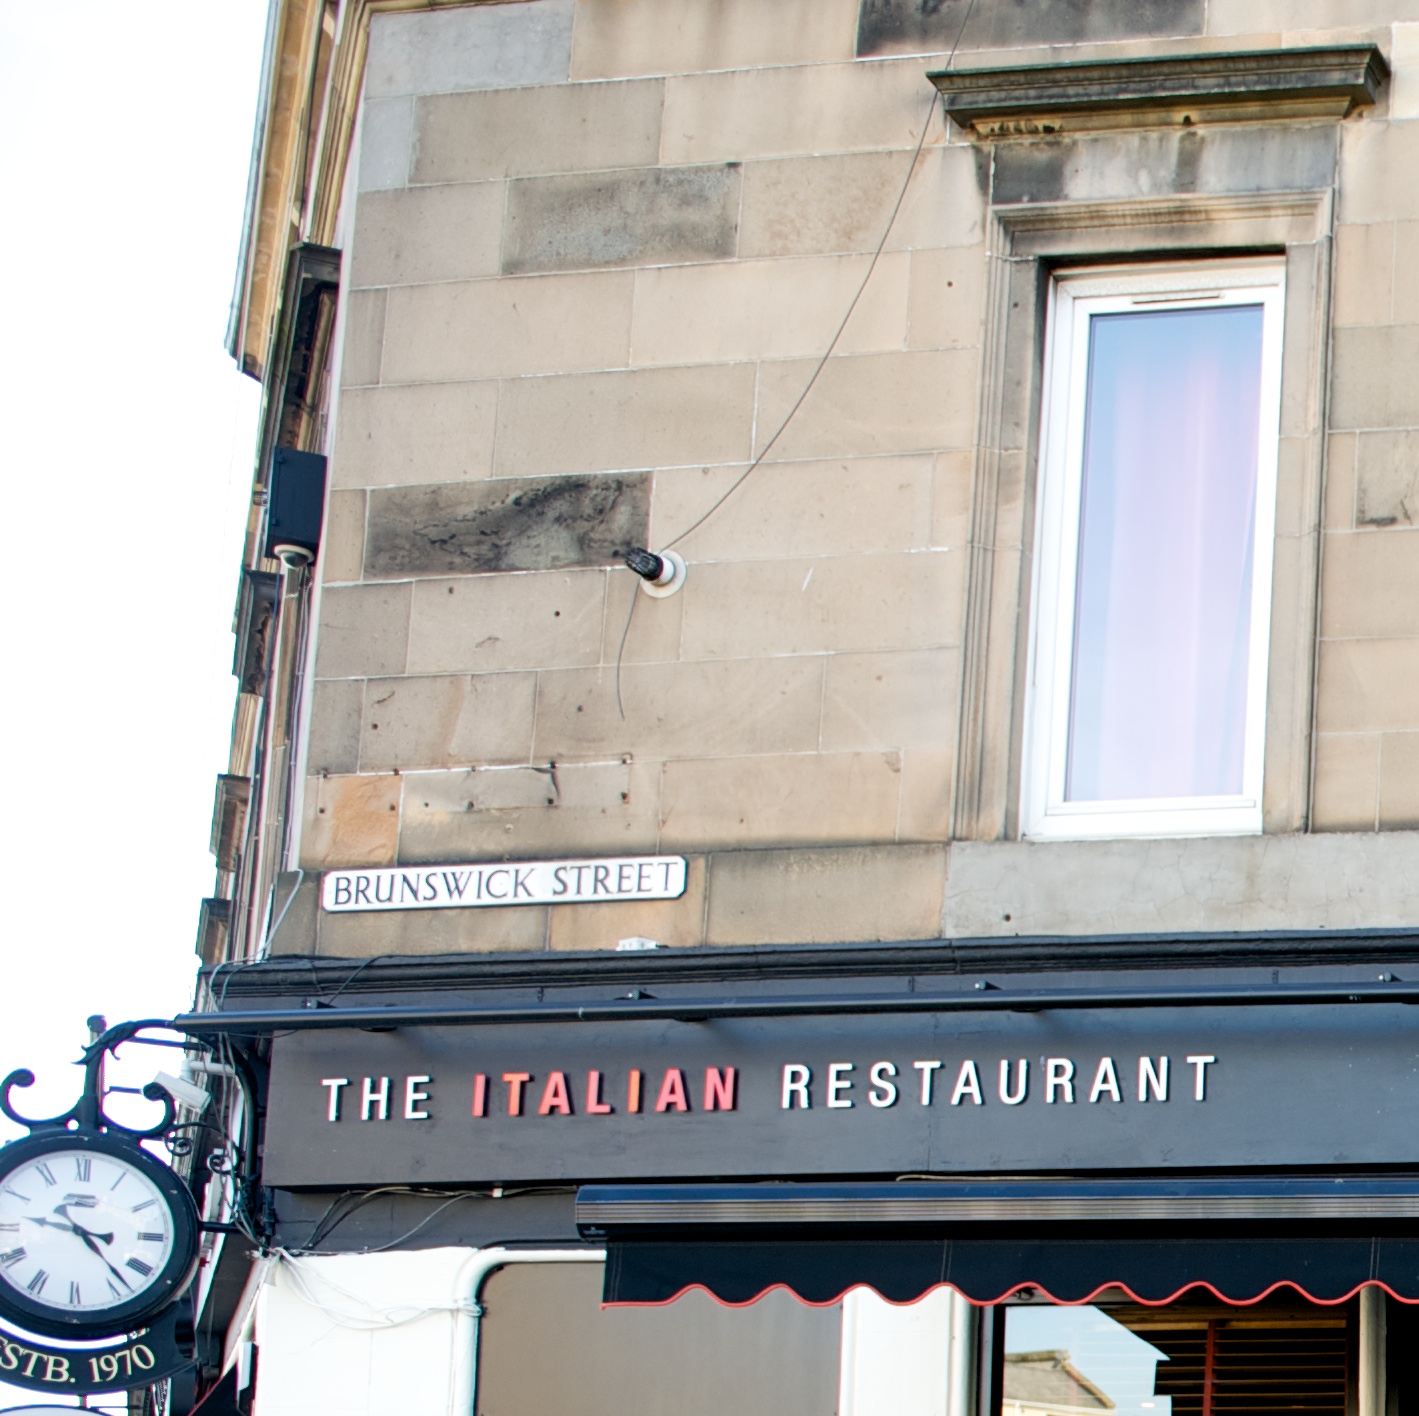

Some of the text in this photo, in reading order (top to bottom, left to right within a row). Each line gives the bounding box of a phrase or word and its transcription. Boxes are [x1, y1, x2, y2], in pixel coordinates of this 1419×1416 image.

[334, 861, 680, 906] BRUNSWICK STREET
[321, 1054, 1215, 1122] THE ITALIAN RESTAURANT
[88, 1344, 155, 1383] 1970
